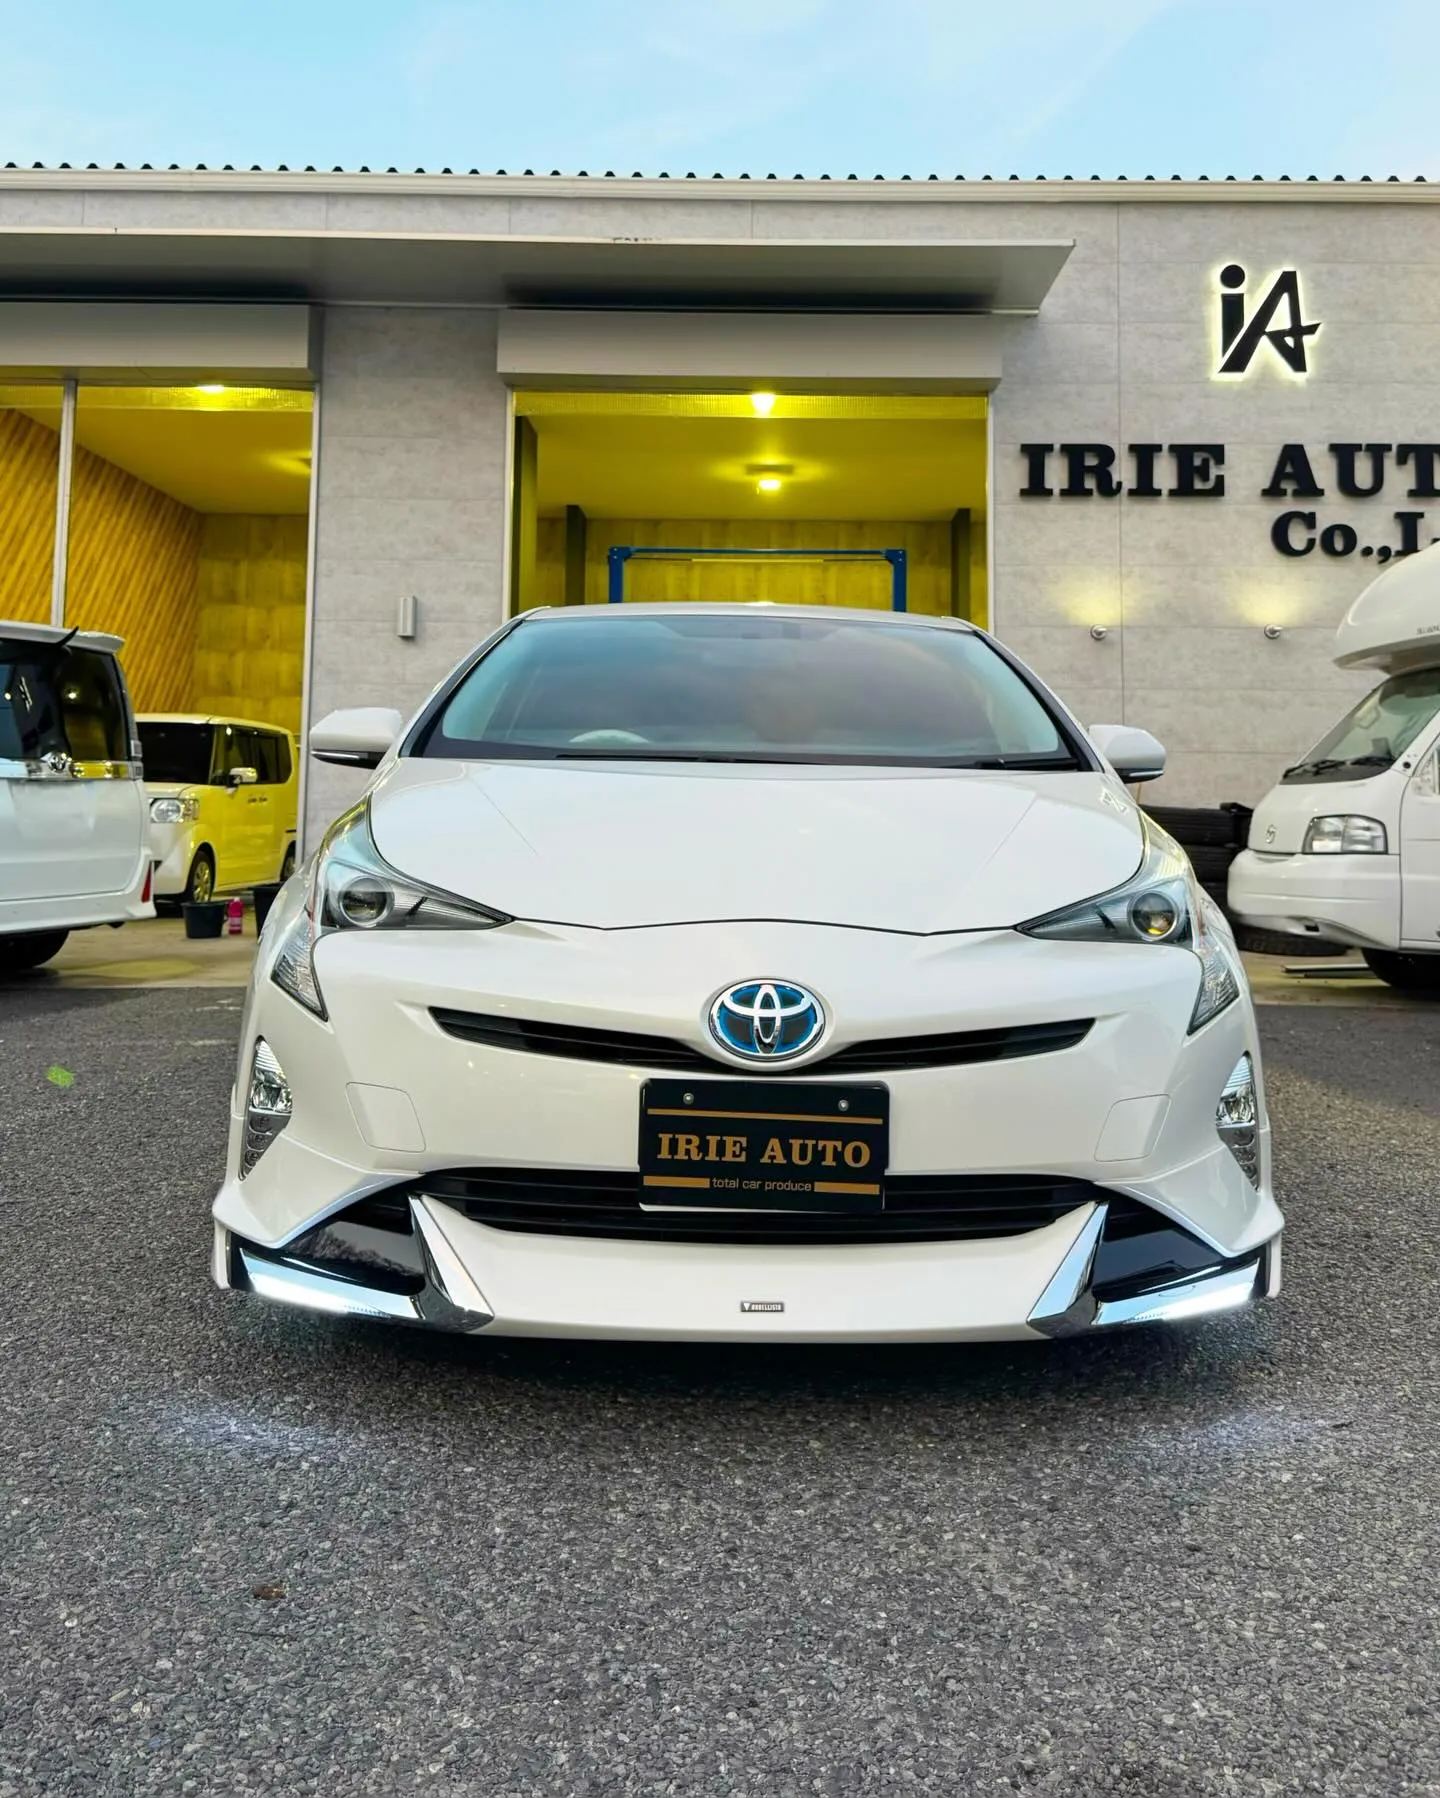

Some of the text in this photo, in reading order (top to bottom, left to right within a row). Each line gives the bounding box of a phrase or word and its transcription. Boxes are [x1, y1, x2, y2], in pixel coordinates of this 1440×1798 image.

[1018, 443, 1226, 498] IRIE
[656, 1132, 871, 1168] IRIE AUTO
[712, 1177, 812, 1192] total car produce
